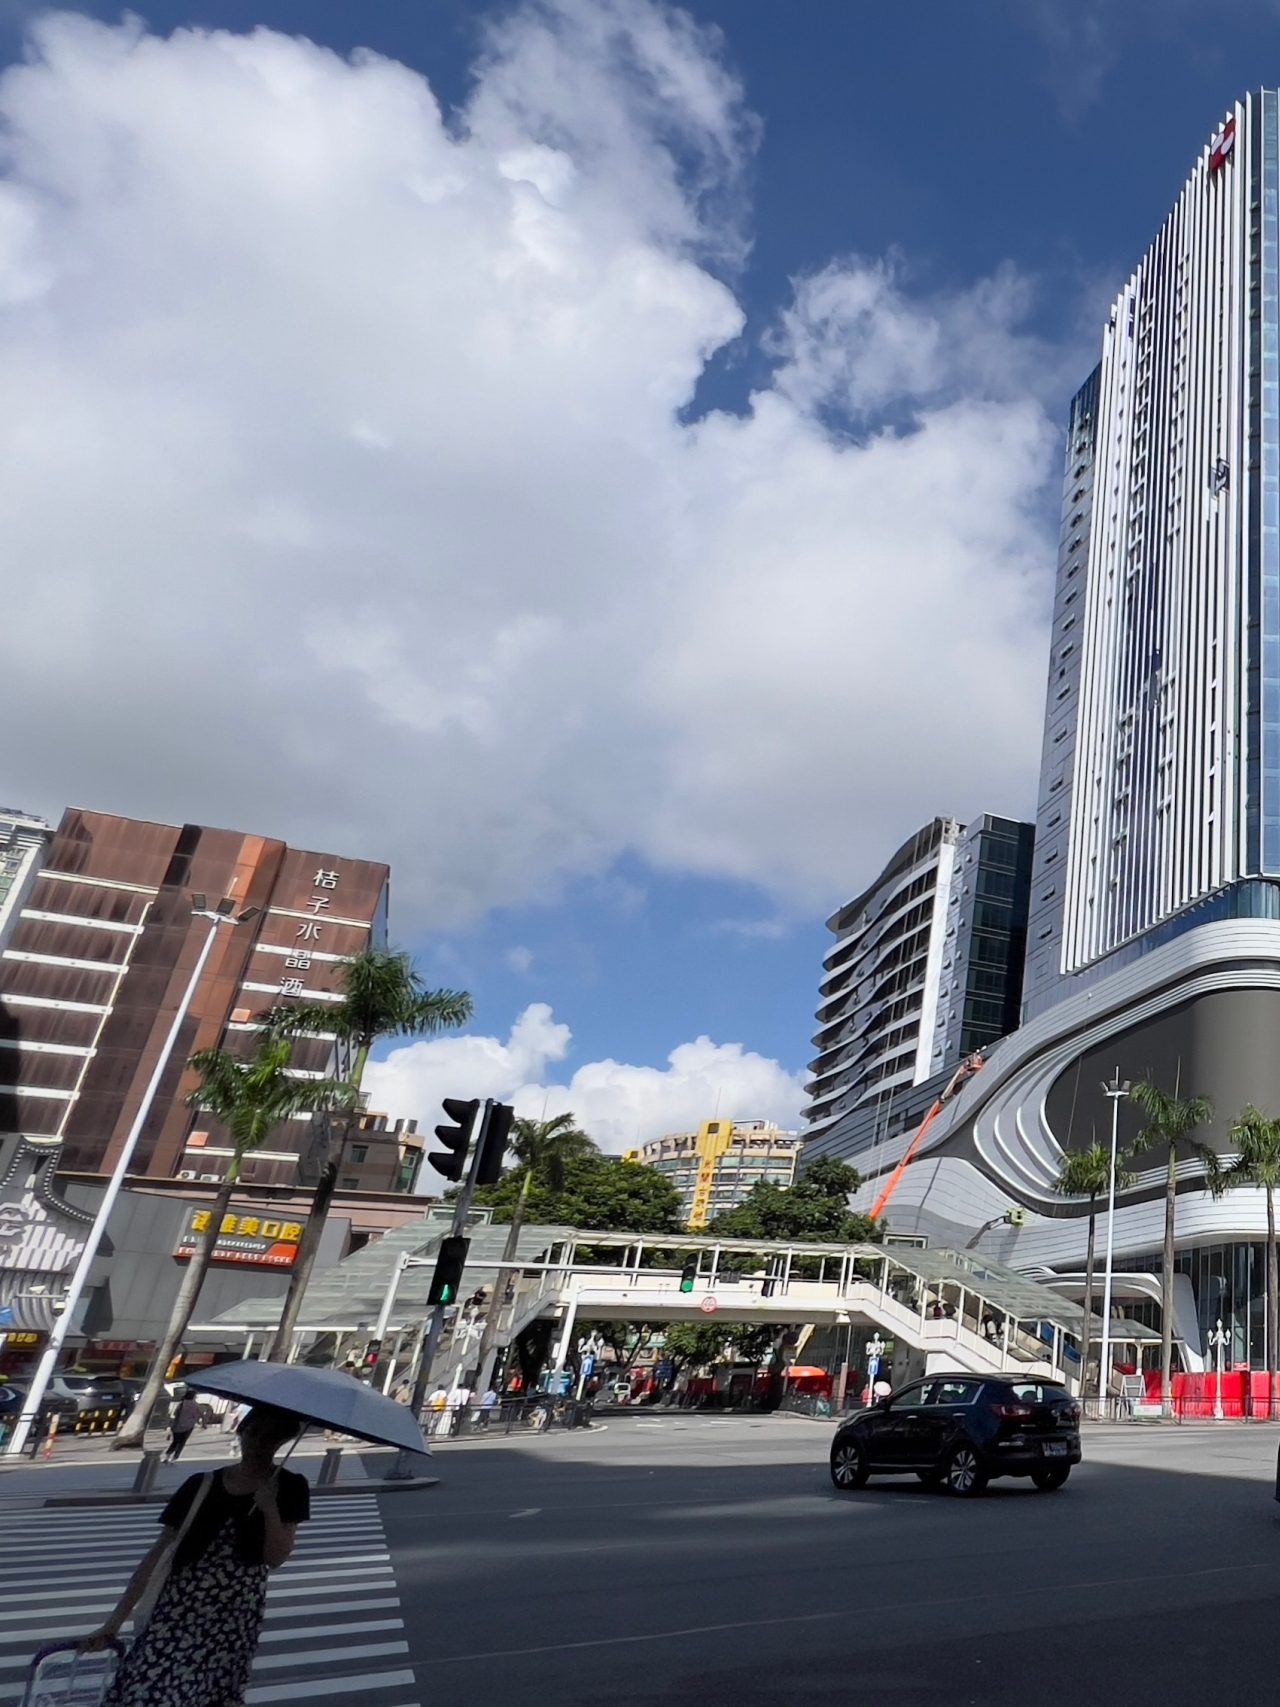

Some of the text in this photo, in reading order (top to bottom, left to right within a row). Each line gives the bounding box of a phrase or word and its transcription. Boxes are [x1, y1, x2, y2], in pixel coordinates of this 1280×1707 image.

[271, 868, 340, 1022] 桔子水晶酒
